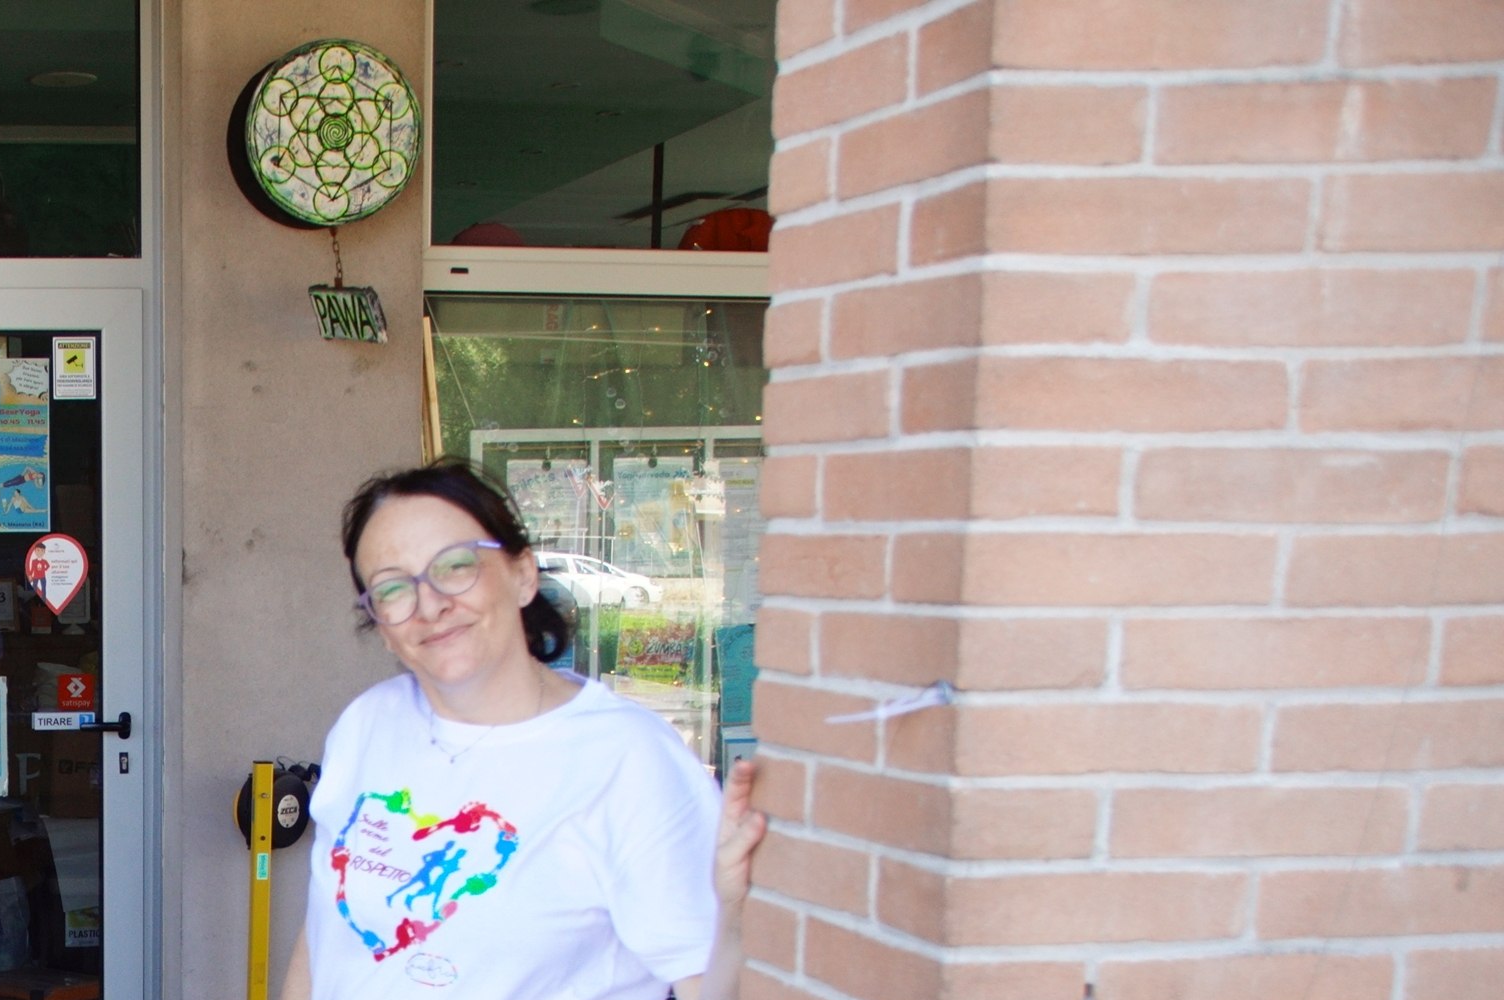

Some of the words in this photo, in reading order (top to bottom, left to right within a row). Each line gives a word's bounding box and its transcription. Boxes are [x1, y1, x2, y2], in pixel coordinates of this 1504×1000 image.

[313, 295, 378, 340] PAWA
[62, 699, 91, 708] satispay
[37, 718, 73, 726] TIRARE
[350, 855, 412, 883] RISPETTO
